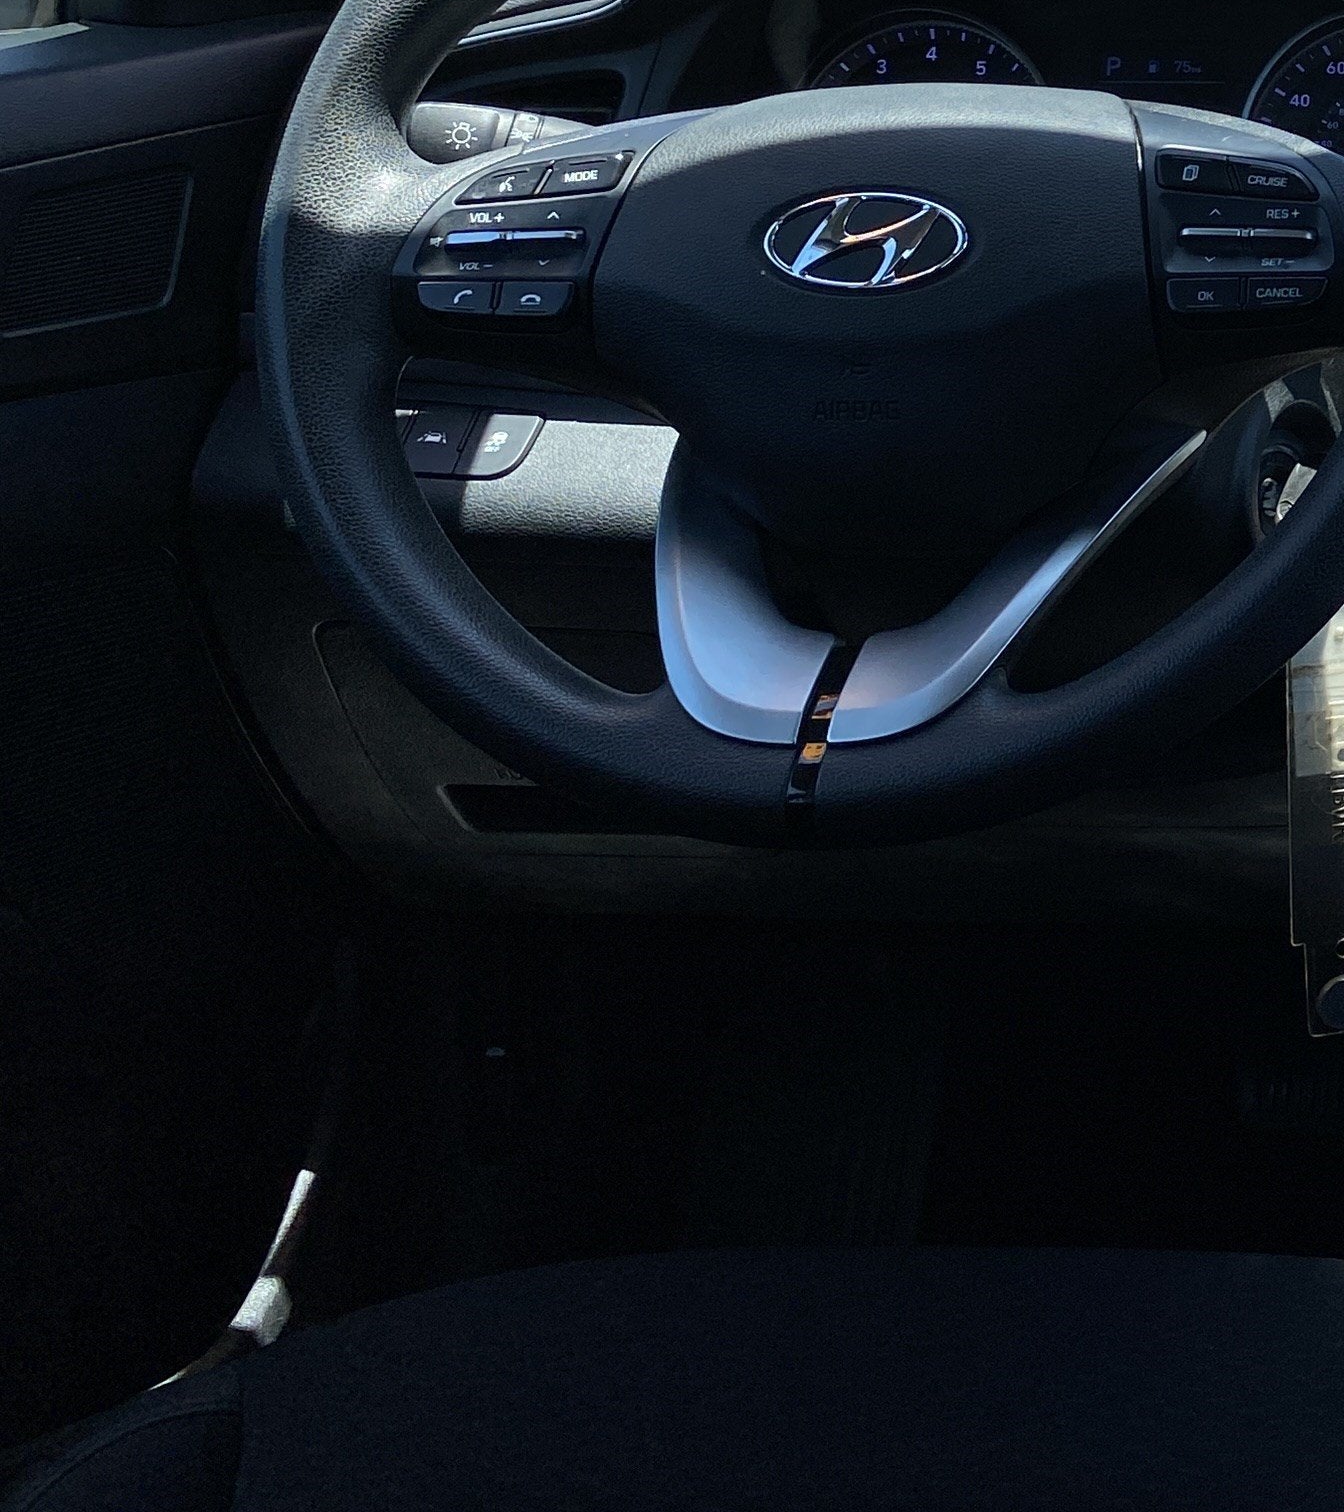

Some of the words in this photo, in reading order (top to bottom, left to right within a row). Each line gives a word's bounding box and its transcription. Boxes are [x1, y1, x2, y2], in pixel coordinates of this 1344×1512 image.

[925, 46, 938, 61] 4
[876, 59, 887, 74] 3
[975, 61, 987, 75] 5
[1106, 56, 1120, 76] P
[1289, 94, 1310, 107] 40
[1327, 121, 1338, 129] 60
[564, 169, 599, 183] MODE
[1247, 174, 1289, 187] CRUISE
[1266, 209, 1289, 219] RES
[459, 262, 480, 270] VOL
[1261, 258, 1283, 266] SET
[1197, 291, 1214, 301] OK
[1256, 288, 1303, 298] CANCEL
[813, 399, 900, 421] AIRBAG
